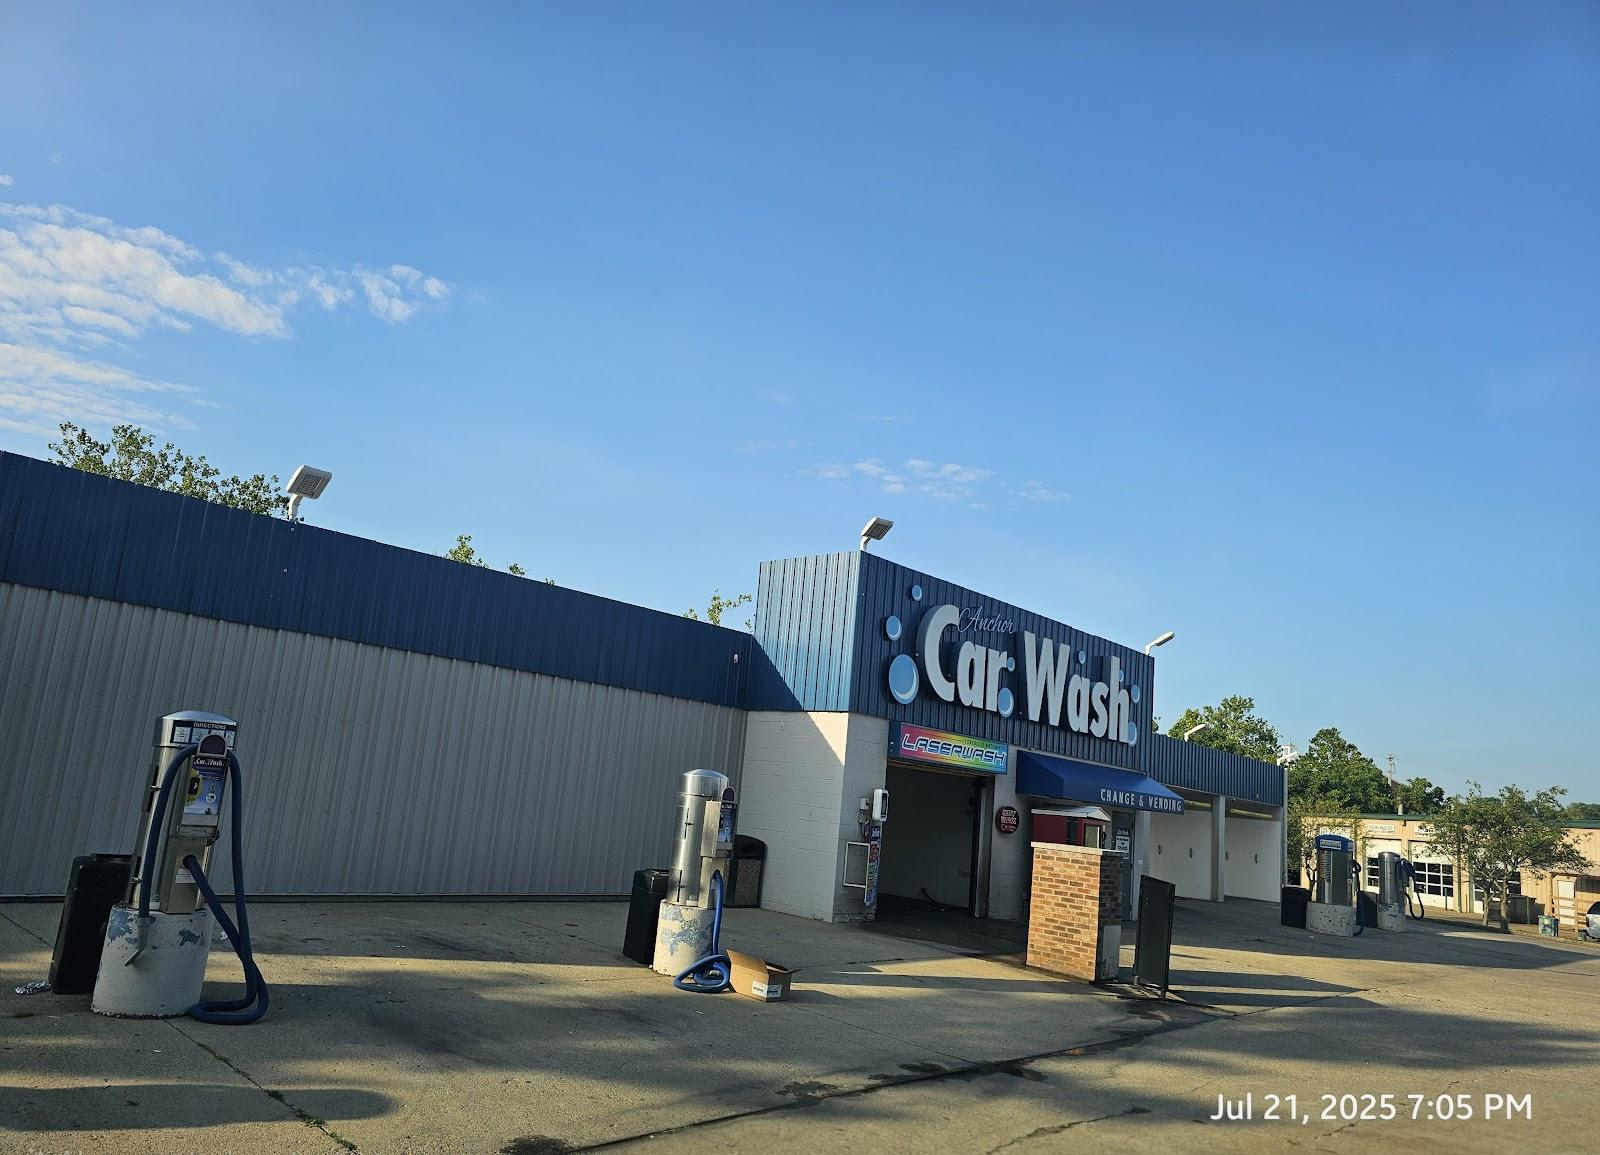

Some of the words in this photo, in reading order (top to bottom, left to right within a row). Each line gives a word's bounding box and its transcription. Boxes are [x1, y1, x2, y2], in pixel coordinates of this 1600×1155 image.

[958, 605, 1015, 634] Anchor
[921, 604, 1008, 713] Car
[1024, 631, 1131, 743] Wash
[193, 722, 227, 730] DIRECTIONS
[901, 733, 1008, 766] LASERWASH
[1100, 788, 1135, 806] CHANGE
[1139, 795, 1144, 807] &
[1148, 795, 1182, 812] VENDING
